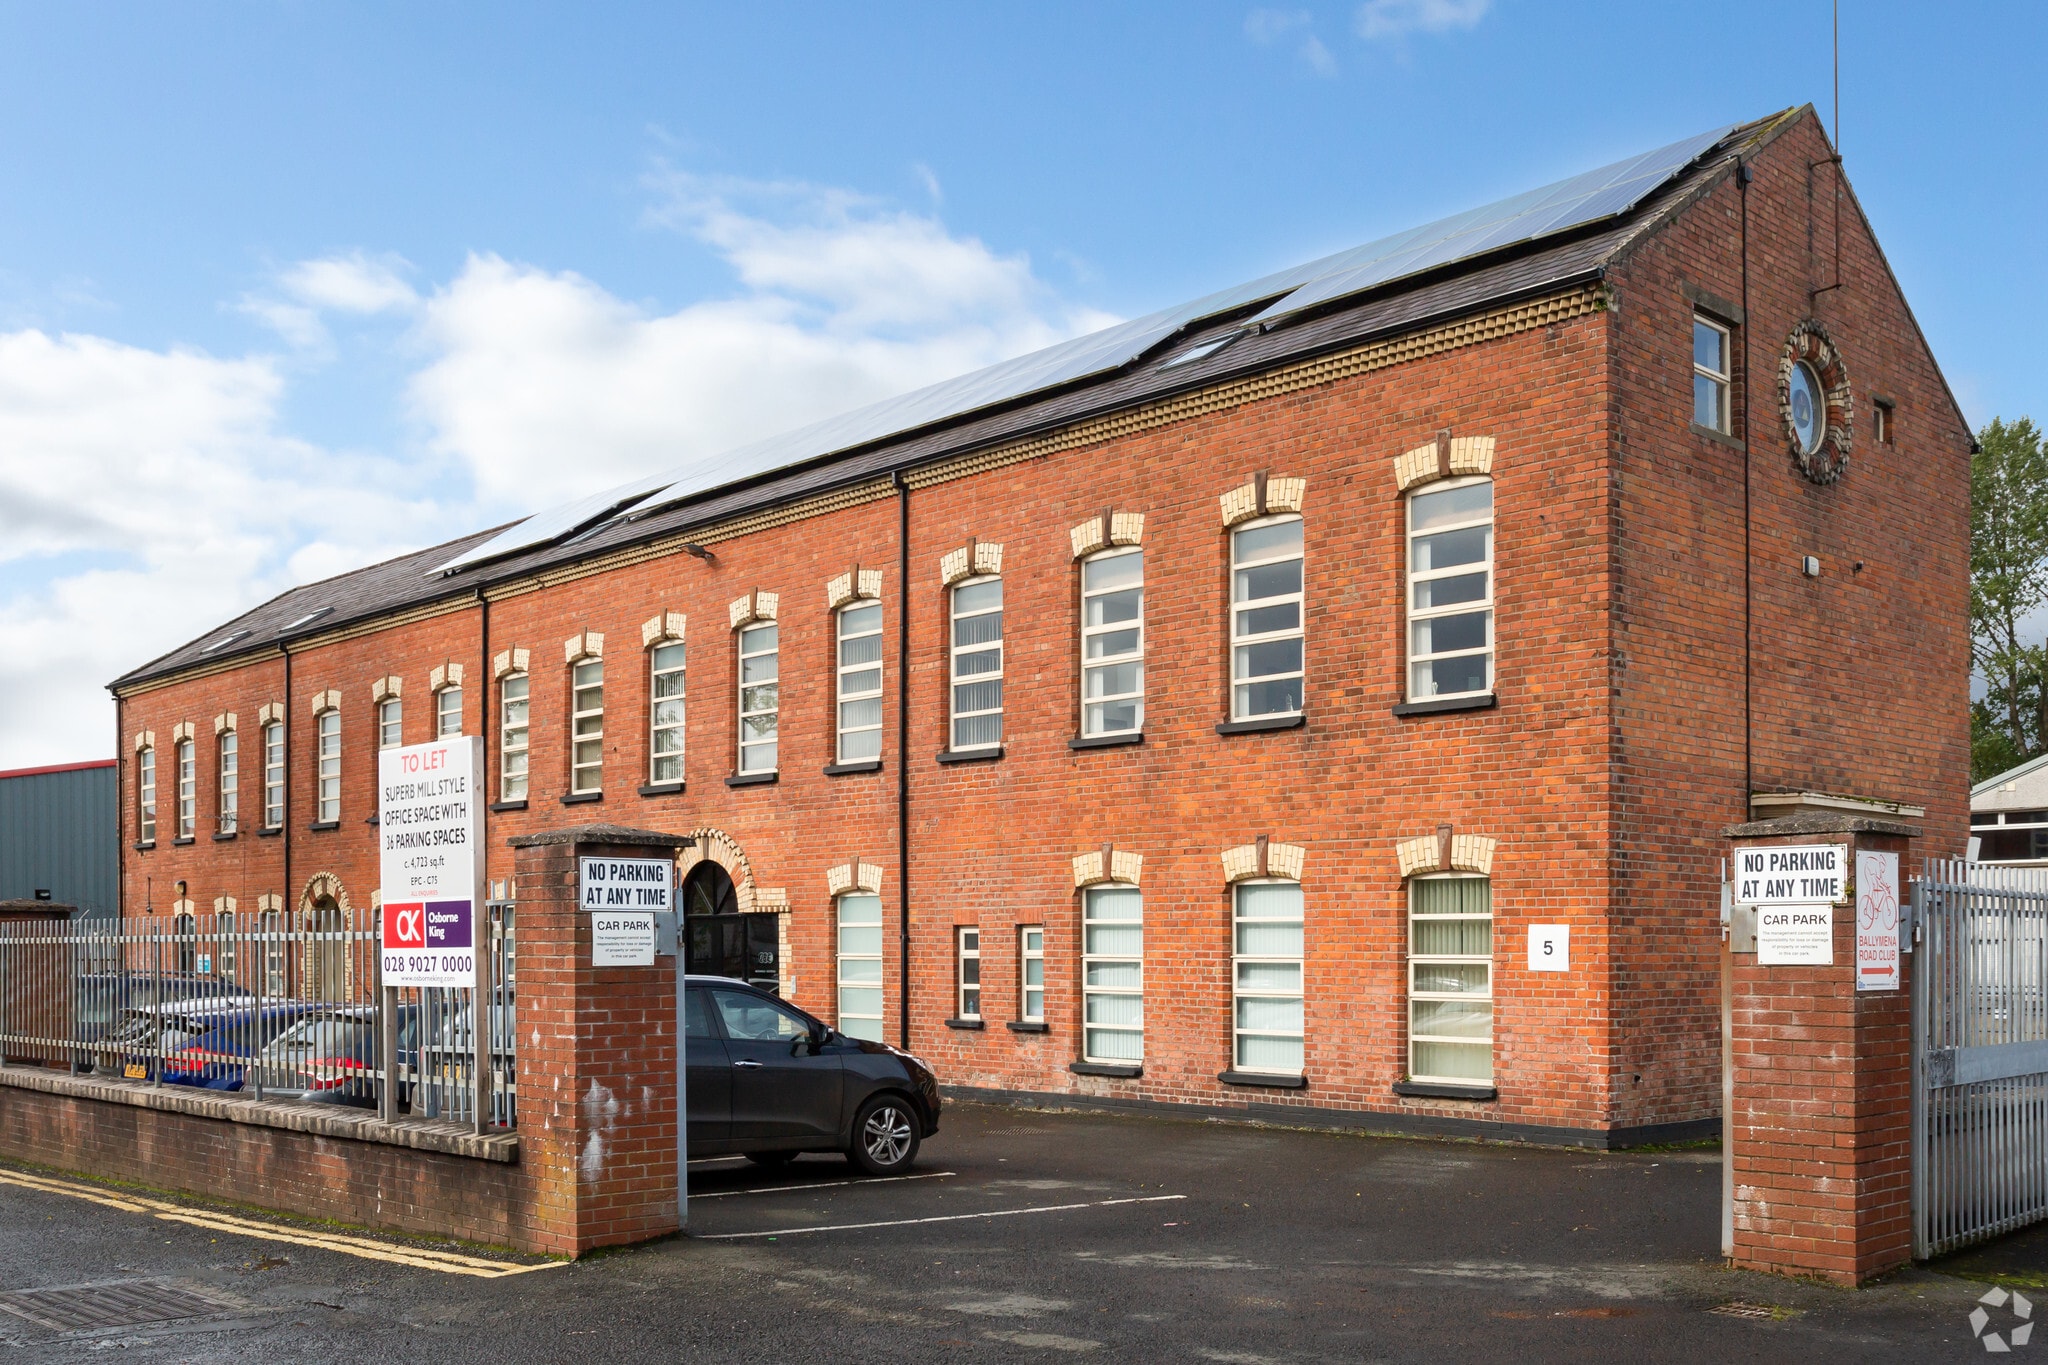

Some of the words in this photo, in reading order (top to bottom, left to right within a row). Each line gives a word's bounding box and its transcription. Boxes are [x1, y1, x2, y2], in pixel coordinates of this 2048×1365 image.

[401, 753, 419, 774] TO
[423, 749, 447, 771] LET
[385, 783, 415, 803] SUPERB
[417, 780, 436, 799] MILL
[438, 776, 465, 796] STYLE
[385, 807, 412, 827] OFFICE
[414, 804, 440, 824] SPACE
[441, 801, 467, 820] WITH
[386, 834, 394, 851] 36
[395, 831, 431, 850] PARKING
[433, 827, 466, 846] SPACES
[404, 859, 410, 869] c.
[411, 856, 428, 870] 4,723
[430, 854, 445, 870] sq.ft
[1745, 853, 1764, 872] NO
[1770, 851, 1836, 872] PARKING
[411, 876, 422, 886] EPC
[426, 875, 438, 885] C75
[588, 863, 606, 880] NO
[610, 864, 664, 882] PARKING
[418, 889, 438, 897] ENQUIRIES
[1742, 880, 1759, 898] AT
[1765, 879, 1795, 898] ANY
[1801, 877, 1838, 897] TIME
[586, 887, 603, 904] AT
[606, 887, 632, 905] ANY
[636, 888, 666, 905] TIME
[428, 911, 459, 924] Osborne
[597, 920, 620, 931] CAR
[623, 920, 650, 931] PARK
[1763, 914, 1788, 925] CAR
[1793, 914, 1827, 925] PARK
[428, 926, 445, 941] King
[1859, 936, 1897, 947] BALLYMENA
[1543, 940, 1554, 956] 5
[1859, 950, 1877, 961] ROAD
[1878, 950, 1896, 961] CLUB
[384, 956, 405, 972] 028
[408, 956, 437, 972] 9027
[441, 956, 472, 972] 0000
[401, 975, 456, 983] www.osborneking.com
